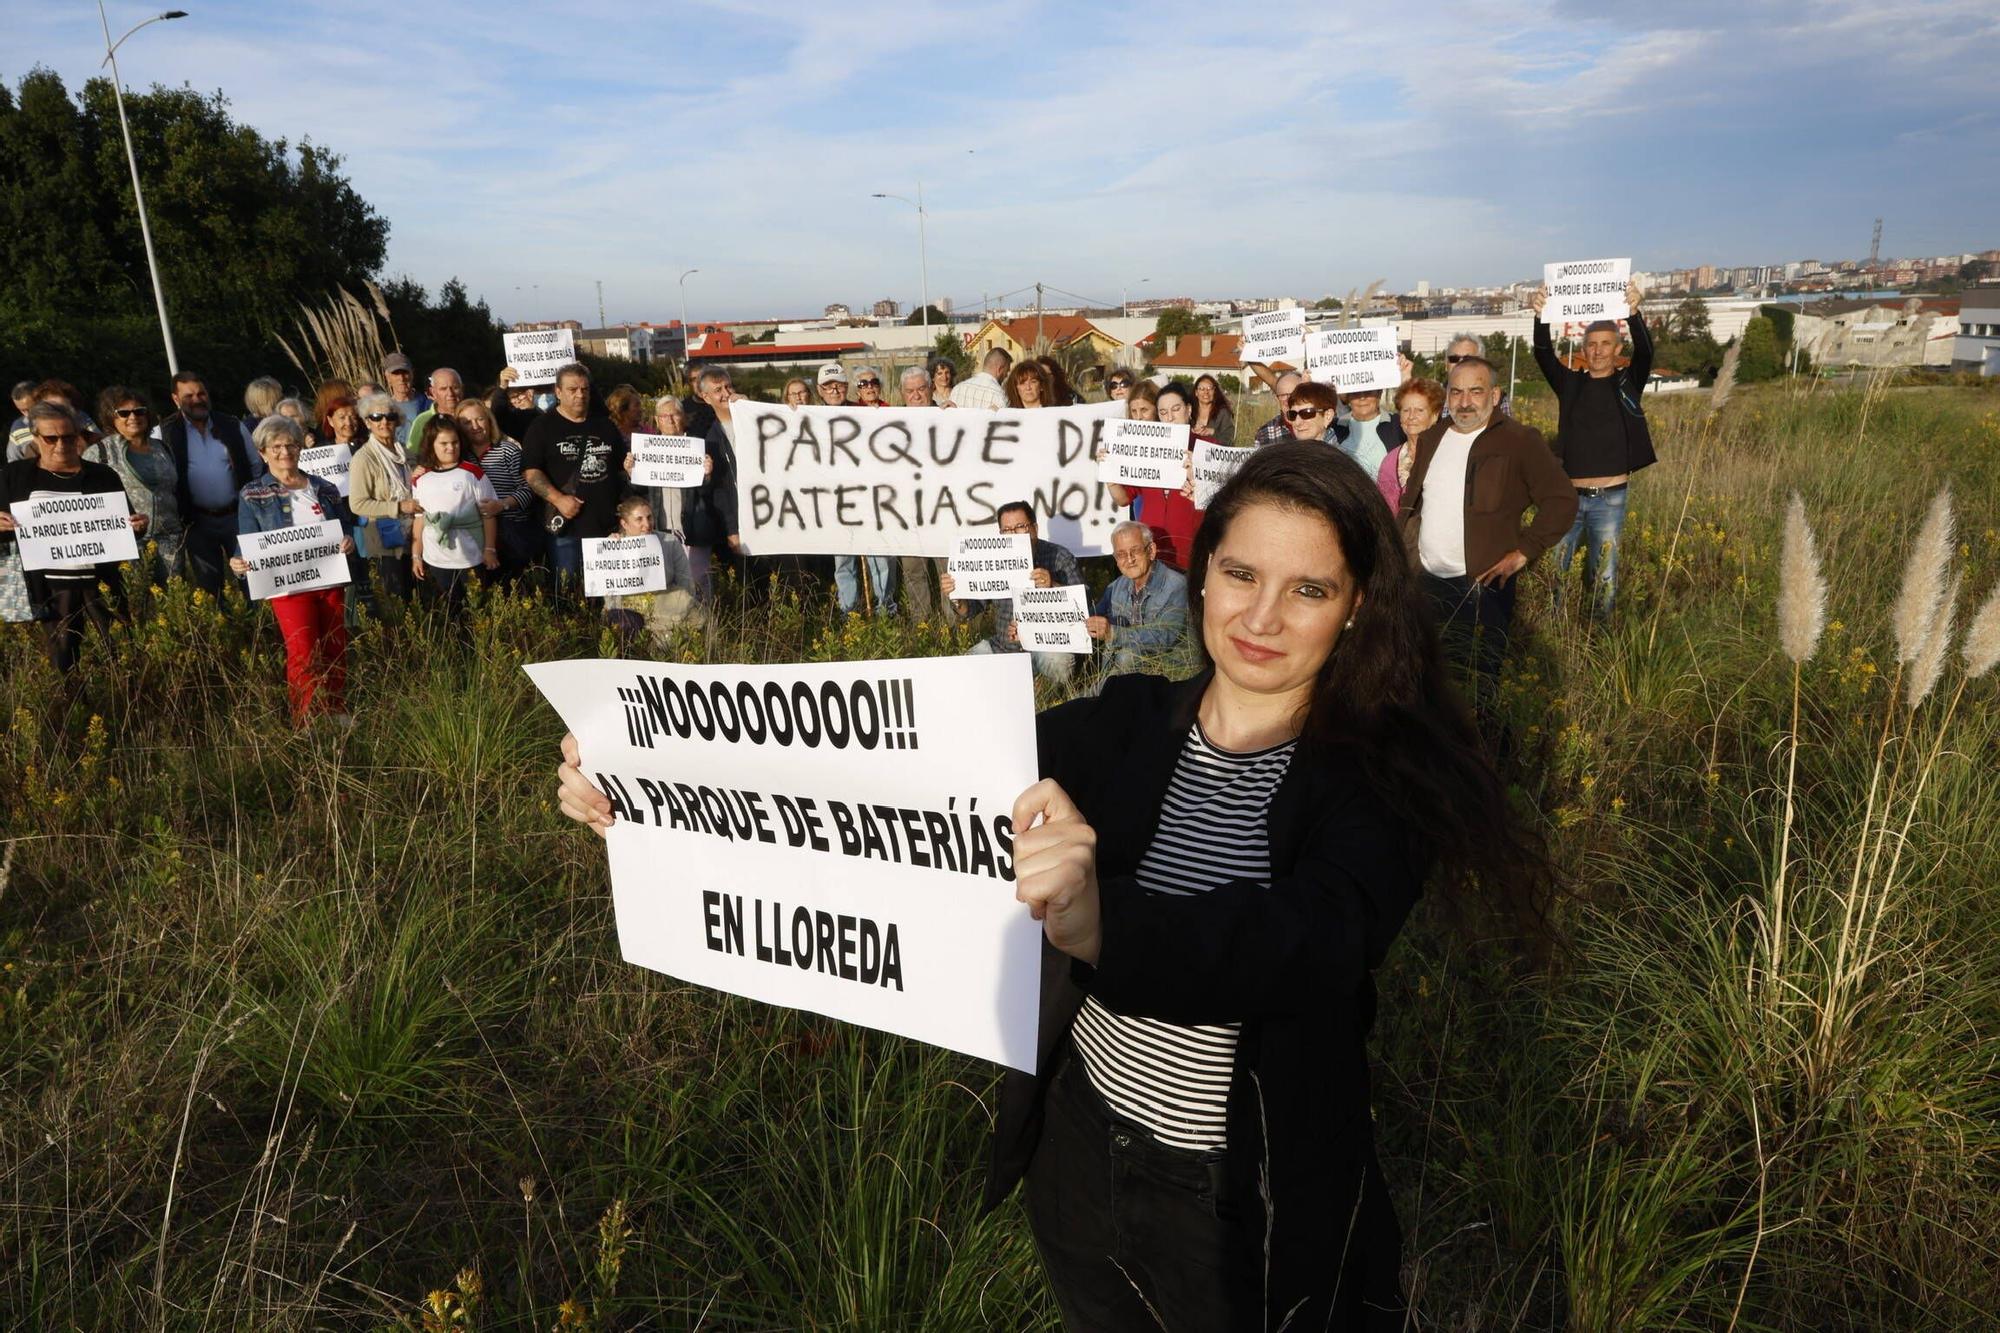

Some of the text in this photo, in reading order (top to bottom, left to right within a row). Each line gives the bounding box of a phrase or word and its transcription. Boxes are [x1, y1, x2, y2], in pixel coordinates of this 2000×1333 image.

[1554, 284, 1582, 297] PARQUE
[1582, 283, 1591, 295] DE
[1562, 303, 1604, 316] EN LLOREDA
[1250, 331, 1270, 342] PARQUE
[1270, 330, 1278, 340] DE
[513, 352, 536, 363] PARQUE
[536, 351, 544, 362] DE
[1257, 345, 1287, 358] EN LLOREDA
[1309, 357, 1318, 369] AL
[1319, 353, 1347, 367] PARQUE
[1349, 352, 1359, 364] DE
[523, 369, 533, 380] EN
[1331, 371, 1375, 386] EN LLOREDA
[756, 412, 1021, 474] PARQUE
[1112, 443, 1138, 457] PARQUE
[1139, 446, 1149, 458] DE
[641, 453, 664, 464] PARQUE
[665, 455, 674, 464] DE
[650, 471, 685, 481] EN LLOREDA
[1120, 465, 1160, 480] EN LLOREDA
[1195, 467, 1203, 481] AL
[19, 526, 31, 540] AL
[33, 522, 69, 538] PARQUE
[70, 520, 83, 535] DE
[50, 541, 106, 560] EN LLOREDA
[248, 560, 259, 572] AL
[260, 554, 291, 570] PARQUE
[292, 551, 304, 564] DE
[595, 559, 621, 570] PARQUE
[622, 559, 631, 570] DE
[957, 560, 983, 572] PARQUE
[984, 559, 994, 571] DE
[274, 567, 321, 588] EN LLOREDA
[605, 576, 645, 589] EN LLOREDA
[968, 580, 1010, 592] EN LLOREDA
[1022, 611, 1046, 623] PARQUE
[1045, 611, 1055, 623] DE
[1034, 632, 1071, 645] EN LLOREDA
[617, 674, 918, 750] ¡¡¡NOOOOOOOO!!!
[595, 772, 645, 825] AL
[635, 776, 777, 844] PARQUE
[771, 794, 830, 853] DE
[702, 890, 904, 993] EN LLOREDA
